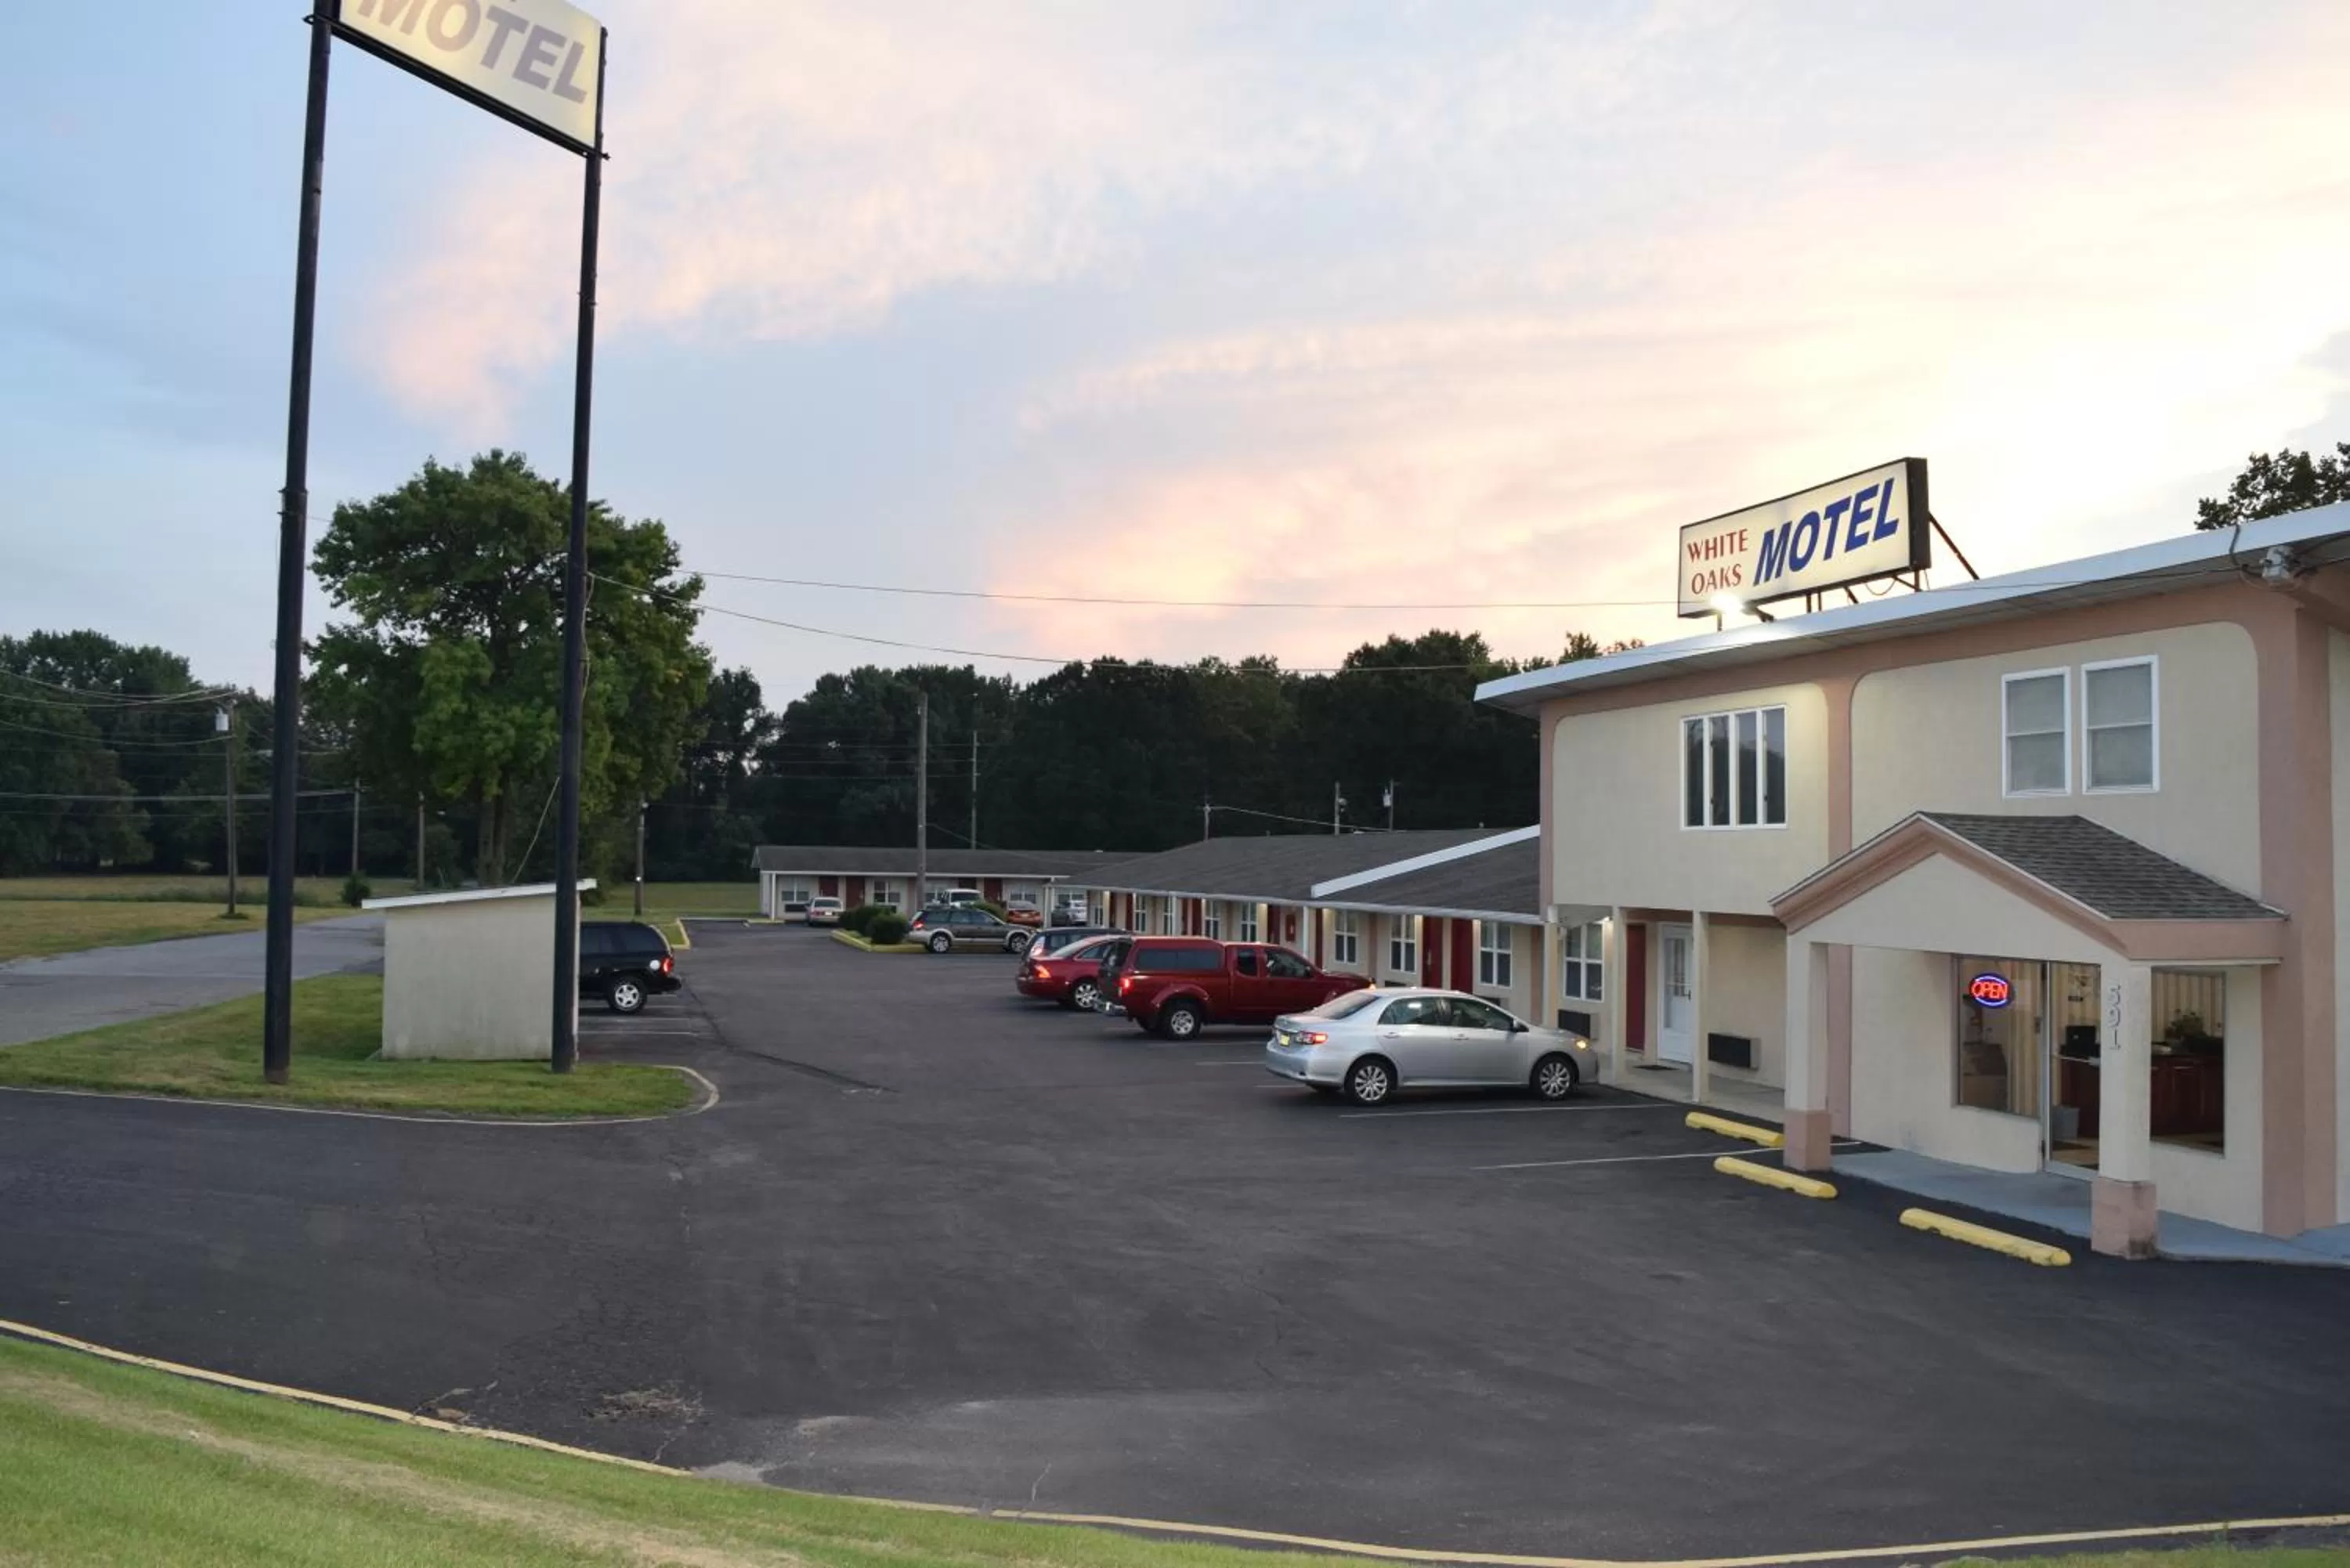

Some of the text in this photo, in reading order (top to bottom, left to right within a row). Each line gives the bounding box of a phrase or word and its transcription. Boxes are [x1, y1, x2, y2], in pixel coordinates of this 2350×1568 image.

[1687, 528, 1748, 563] WHITE
[1752, 477, 1900, 587] MOTEL
[1691, 563, 1742, 595] OAKS
[1971, 981, 2008, 999] OPEN
